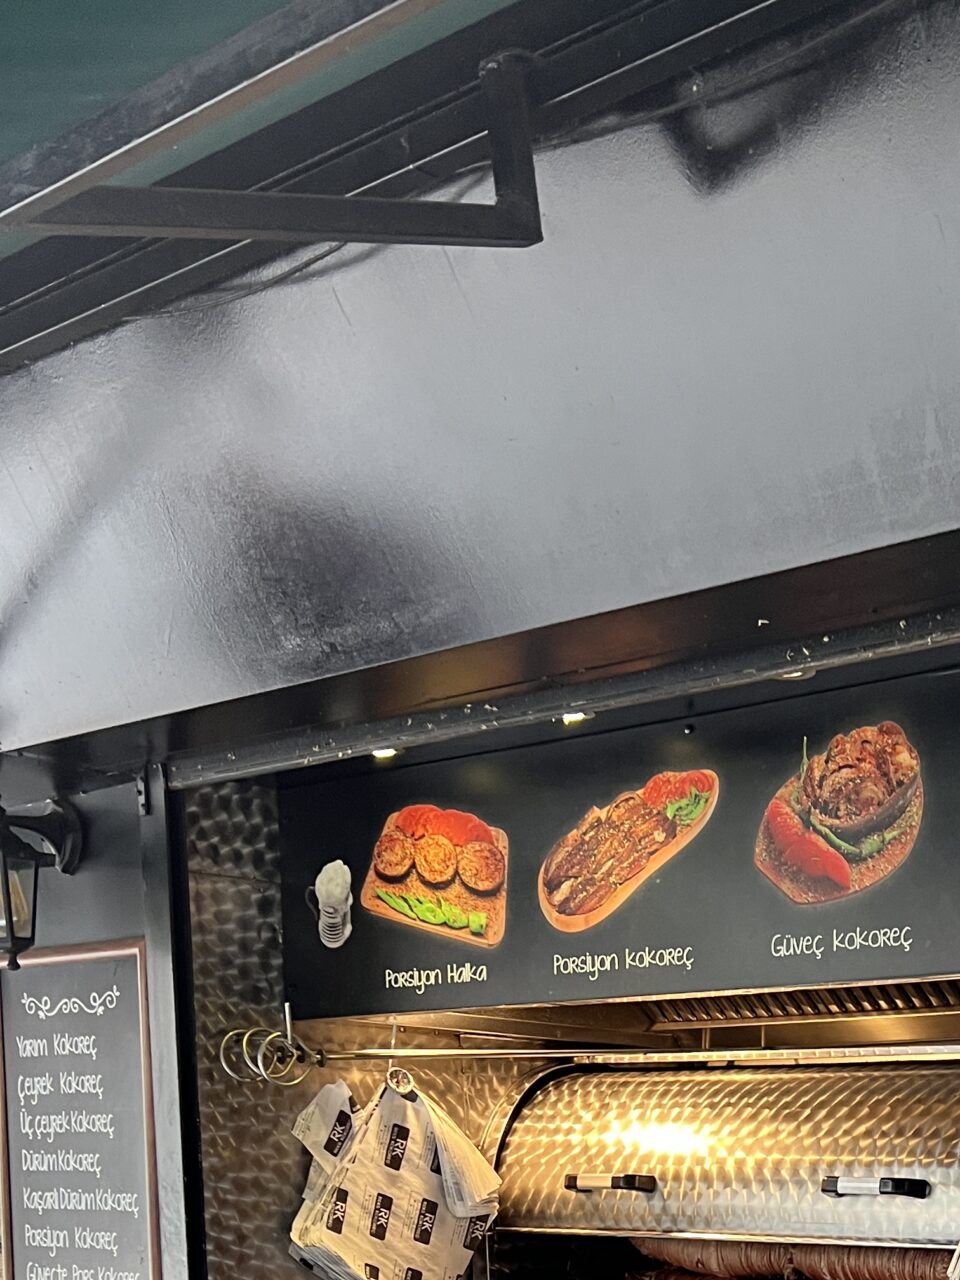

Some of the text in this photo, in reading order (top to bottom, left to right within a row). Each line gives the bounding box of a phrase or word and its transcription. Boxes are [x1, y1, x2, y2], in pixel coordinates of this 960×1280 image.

[770, 932, 825, 959] Güveç
[553, 951, 619, 981] Porsiyon
[385, 962, 488, 995] Porsiyon Halka
[392, 1138, 406, 1158] RK
[376, 1207, 390, 1229] RK
[421, 1212, 435, 1233] RK
